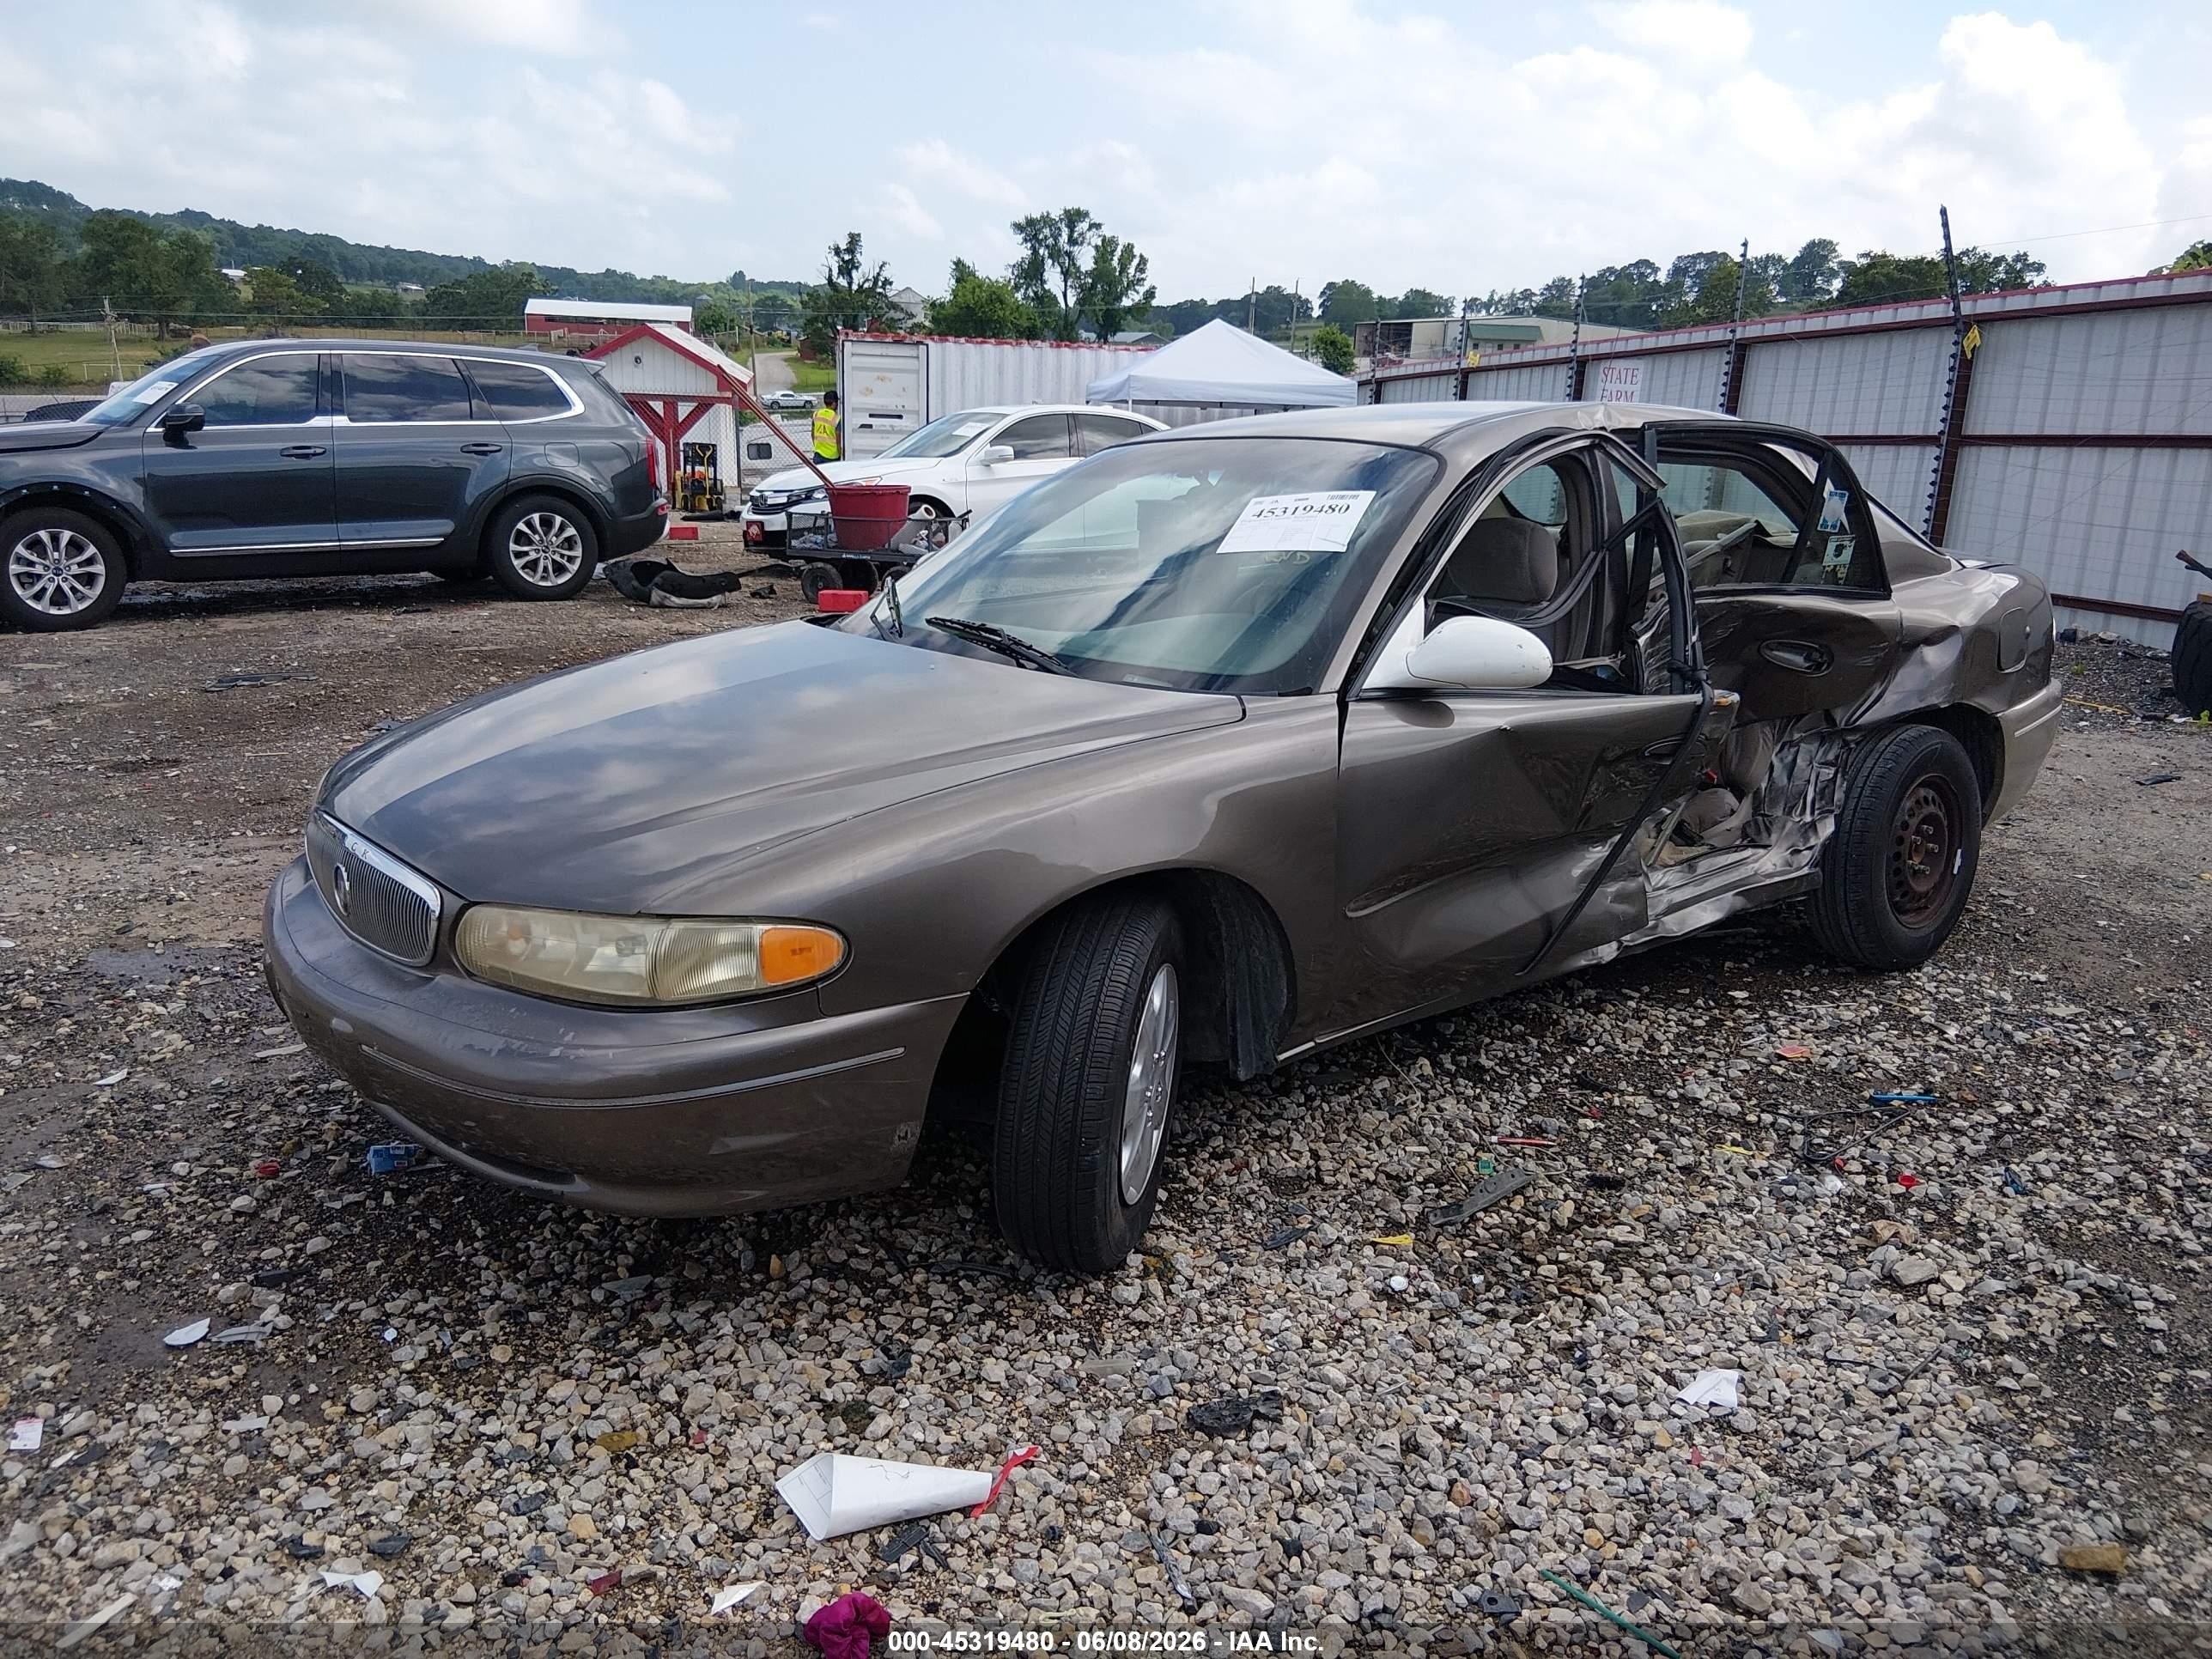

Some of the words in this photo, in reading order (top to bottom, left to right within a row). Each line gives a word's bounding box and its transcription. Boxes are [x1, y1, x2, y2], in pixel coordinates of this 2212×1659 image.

[1601, 366, 1639, 385] STATE
[1601, 389, 1635, 403] FARM
[1252, 503, 1351, 519] 45319480
